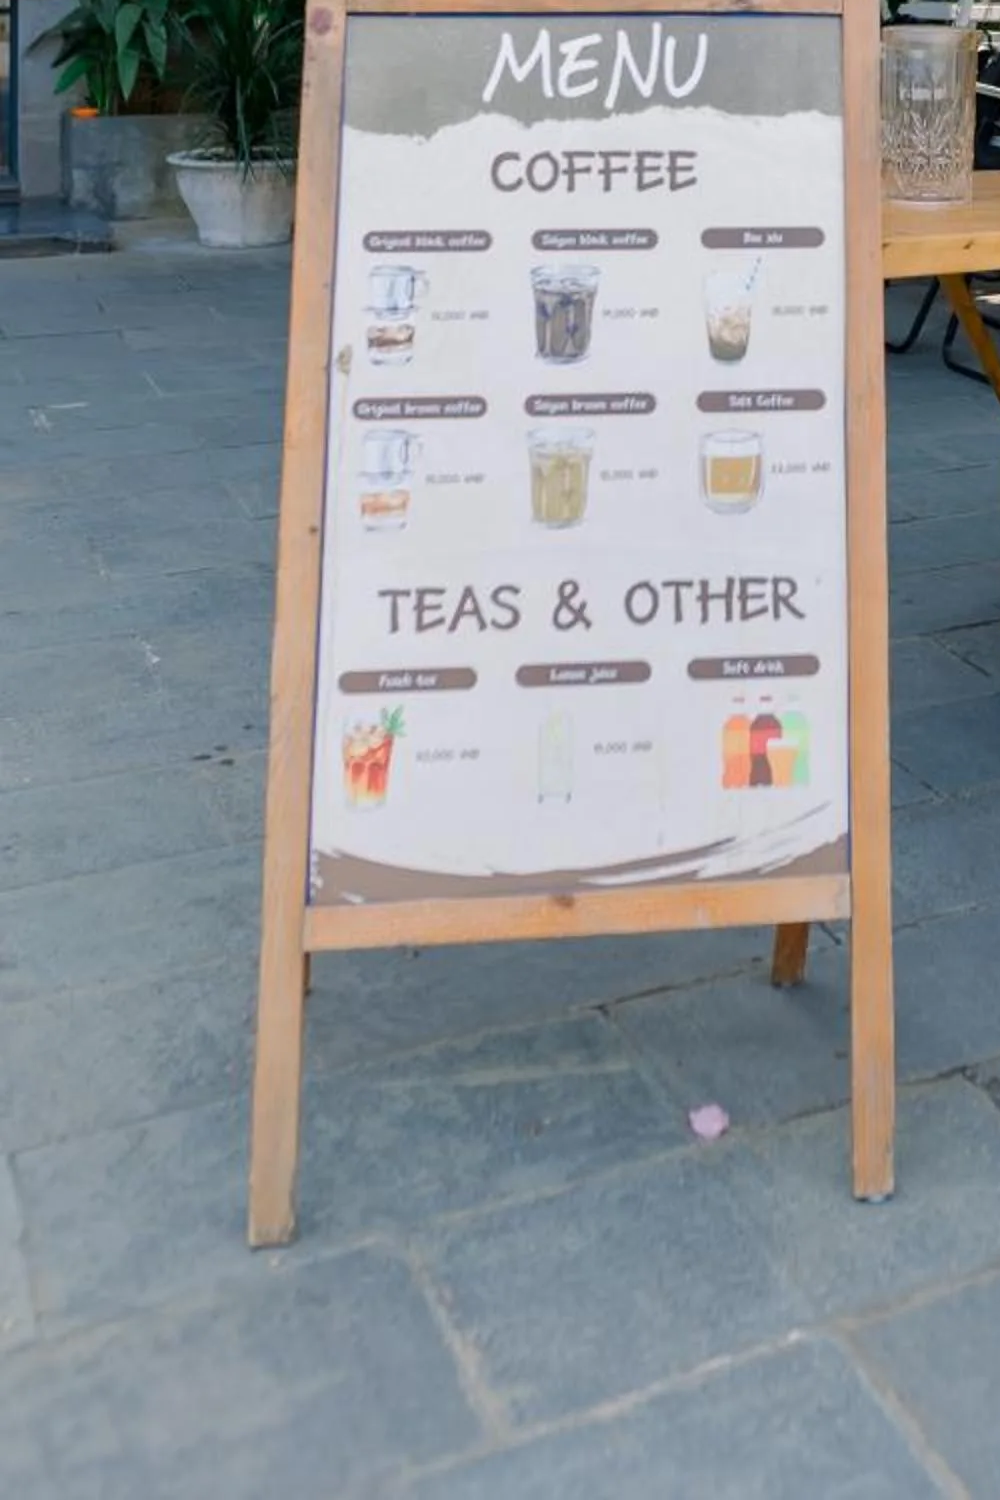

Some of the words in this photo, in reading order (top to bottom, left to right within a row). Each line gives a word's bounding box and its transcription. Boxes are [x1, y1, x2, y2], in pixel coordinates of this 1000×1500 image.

[482, 23, 708, 109] MENU
[491, 149, 698, 193] COFFEE
[447, 233, 486, 247] coffee
[612, 232, 648, 246] coffee
[444, 399, 481, 414] coffee
[610, 395, 648, 411] coffee
[378, 584, 521, 633] TEAS
[552, 579, 592, 630] &
[624, 576, 806, 626] OTHER
[723, 658, 750, 675] Soft
